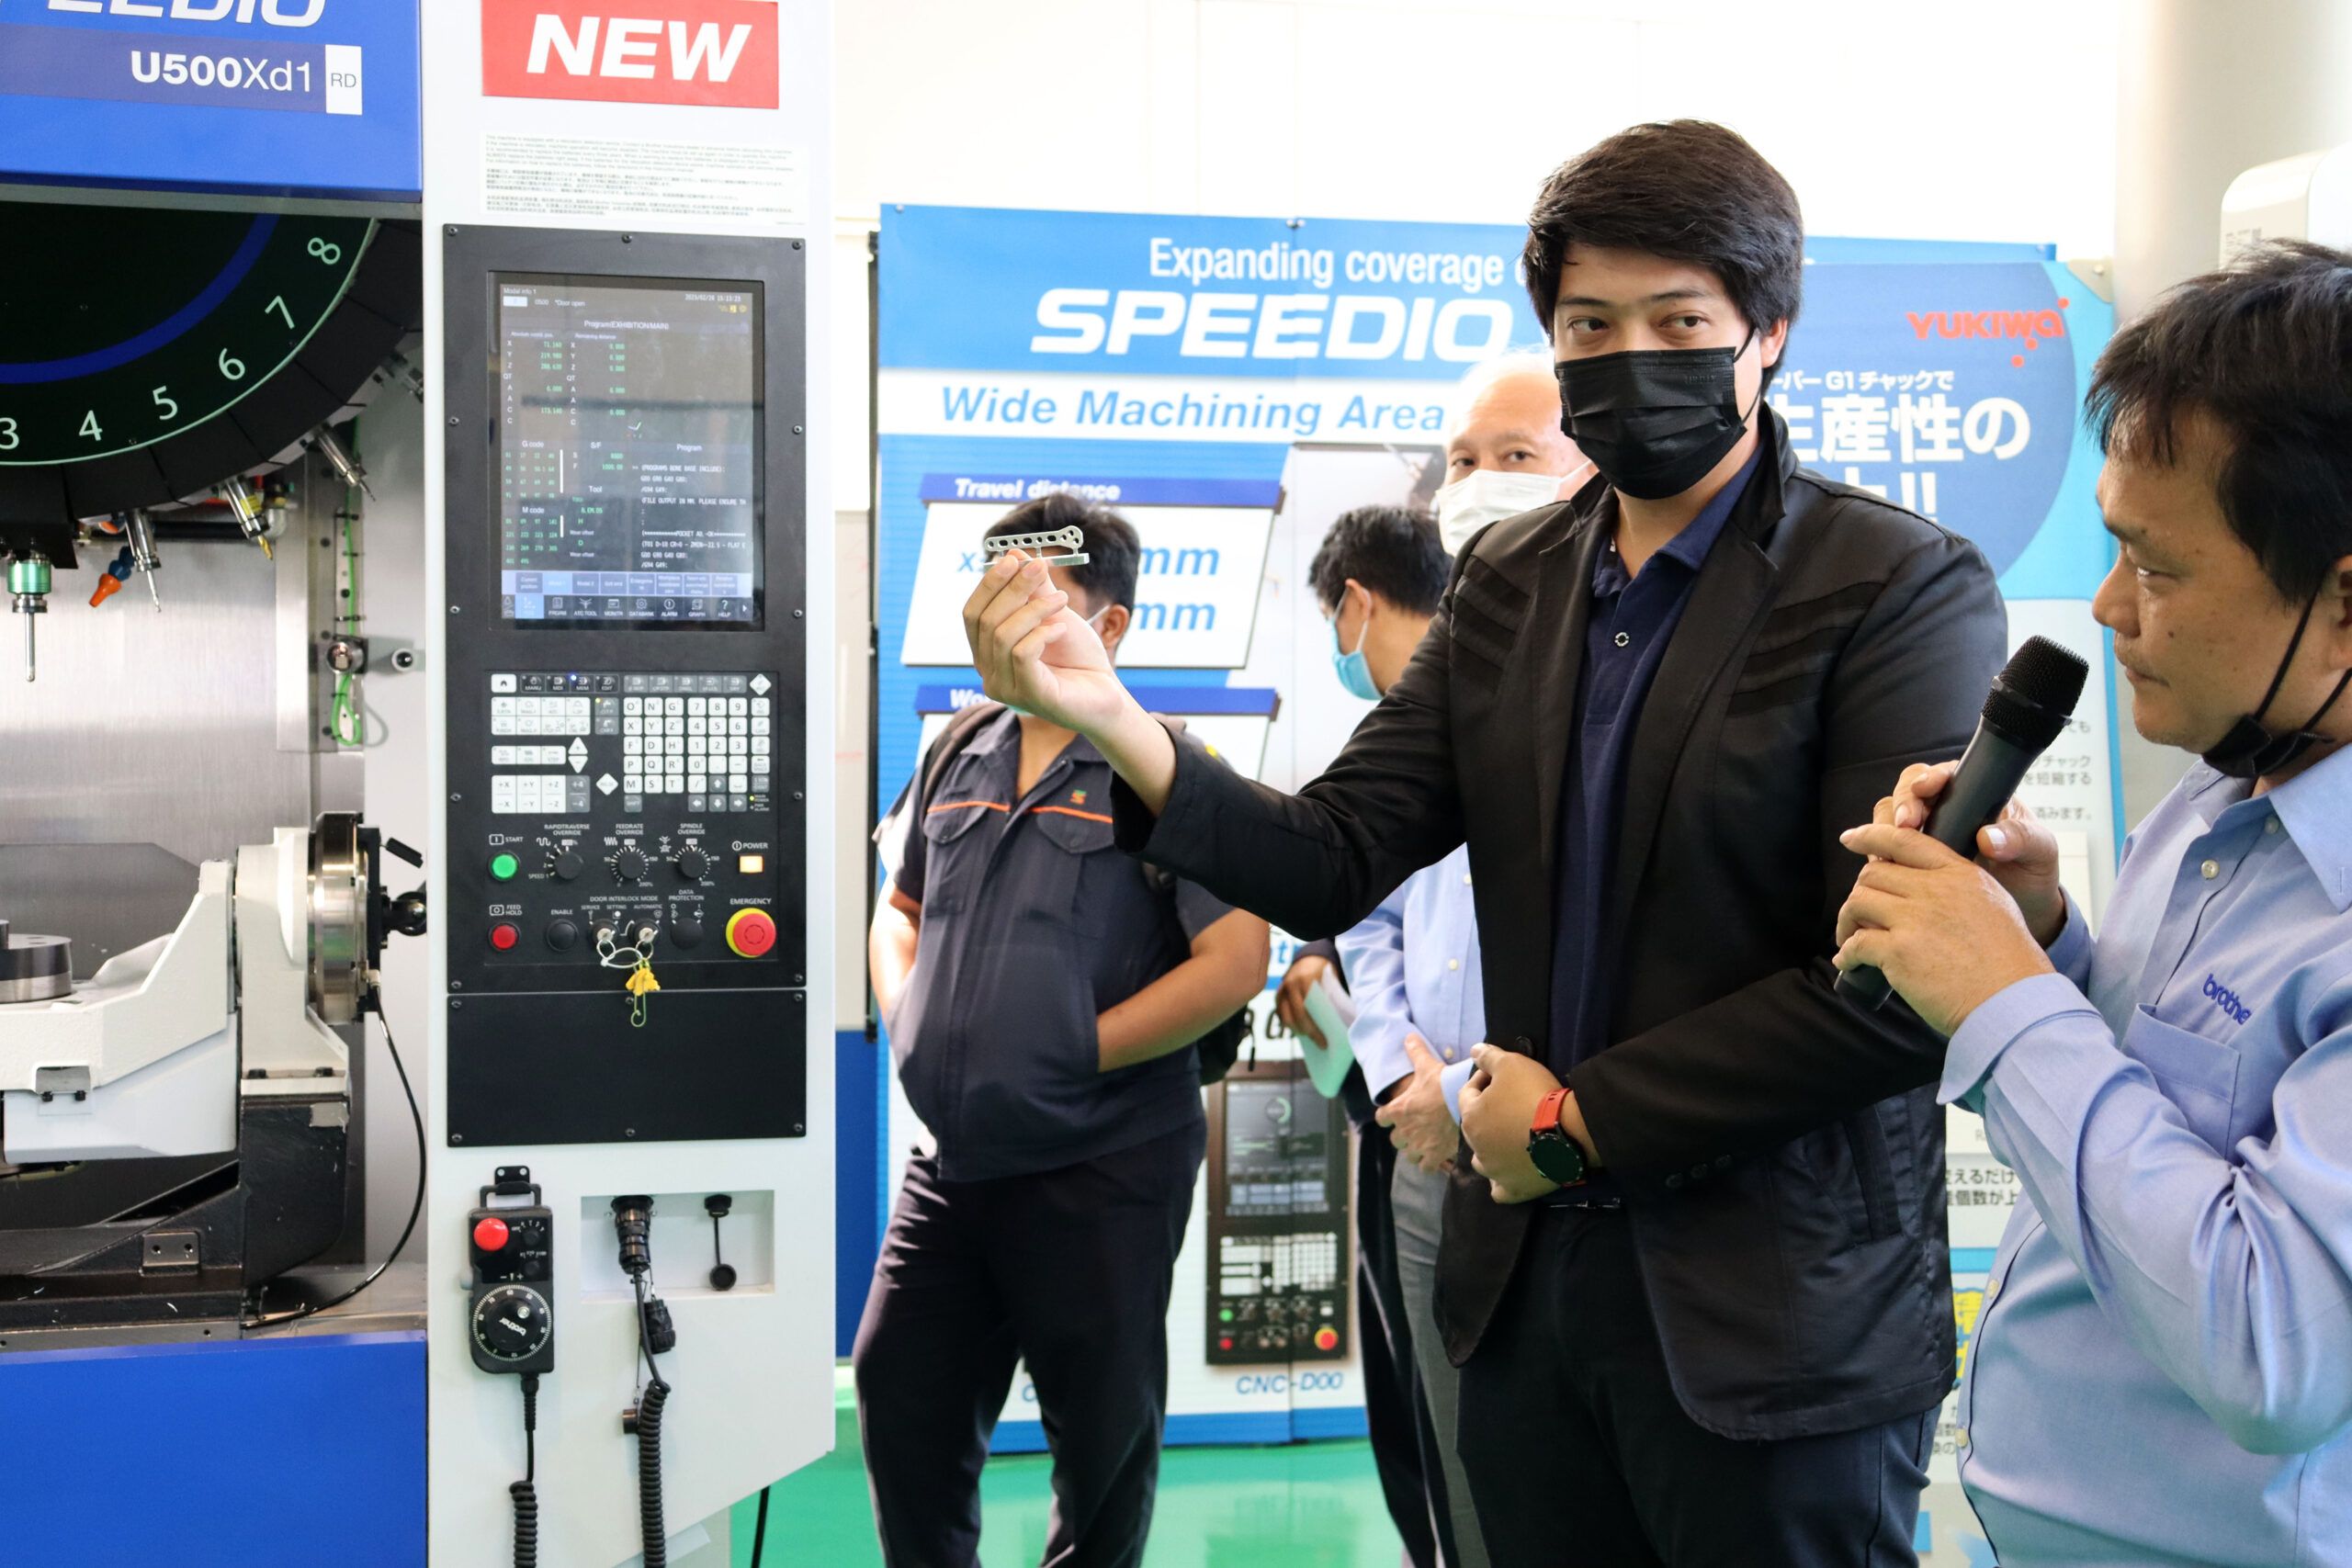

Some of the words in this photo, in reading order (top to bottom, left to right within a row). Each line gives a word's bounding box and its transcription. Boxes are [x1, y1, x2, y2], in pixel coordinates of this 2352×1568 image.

[130, 51, 311, 92] U500Xd1
[526, 14, 752, 83] NEW
[331, 73, 357, 89] RD
[1149, 237, 1334, 288] Expanding
[1344, 247, 1505, 294] coverage
[0, 417, 19, 450] 3
[78, 410, 103, 442] 4
[153, 385, 179, 421] 5
[218, 347, 246, 380] 6
[264, 295, 297, 331] 7
[307, 236, 342, 265] 8
[1030, 288, 1513, 363] SPEEDIO
[941, 386, 1057, 425] Wide
[1076, 389, 1321, 435] Machining
[1338, 394, 1445, 431] Area
[676, 444, 703, 452] Program
[955, 478, 1024, 499] Travel
